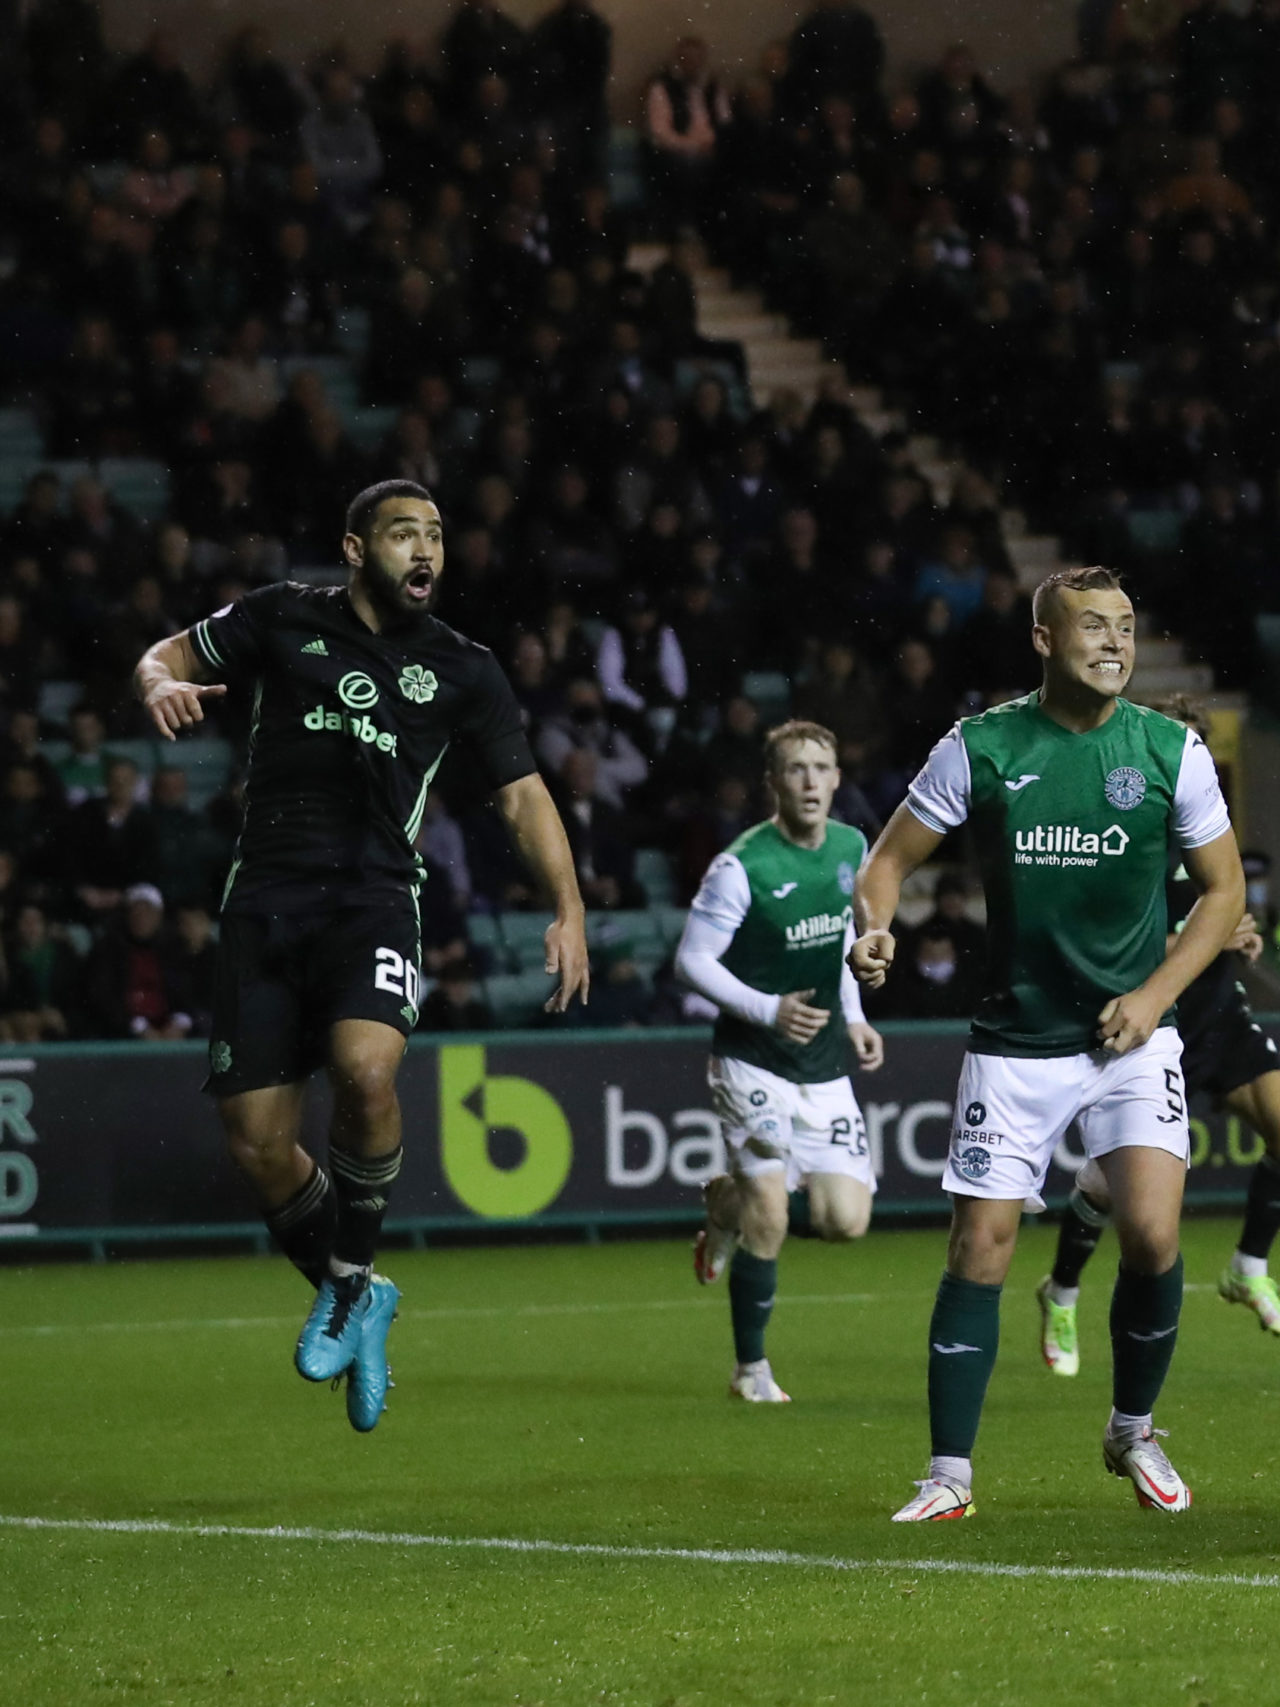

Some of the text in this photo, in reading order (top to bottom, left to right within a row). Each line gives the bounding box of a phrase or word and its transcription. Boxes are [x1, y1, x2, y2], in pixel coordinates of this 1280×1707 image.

[303, 704, 398, 758] daabet
[1014, 852, 1099, 868] life with power
[1015, 824, 1100, 854] utilita
[374, 946, 418, 1013] 20
